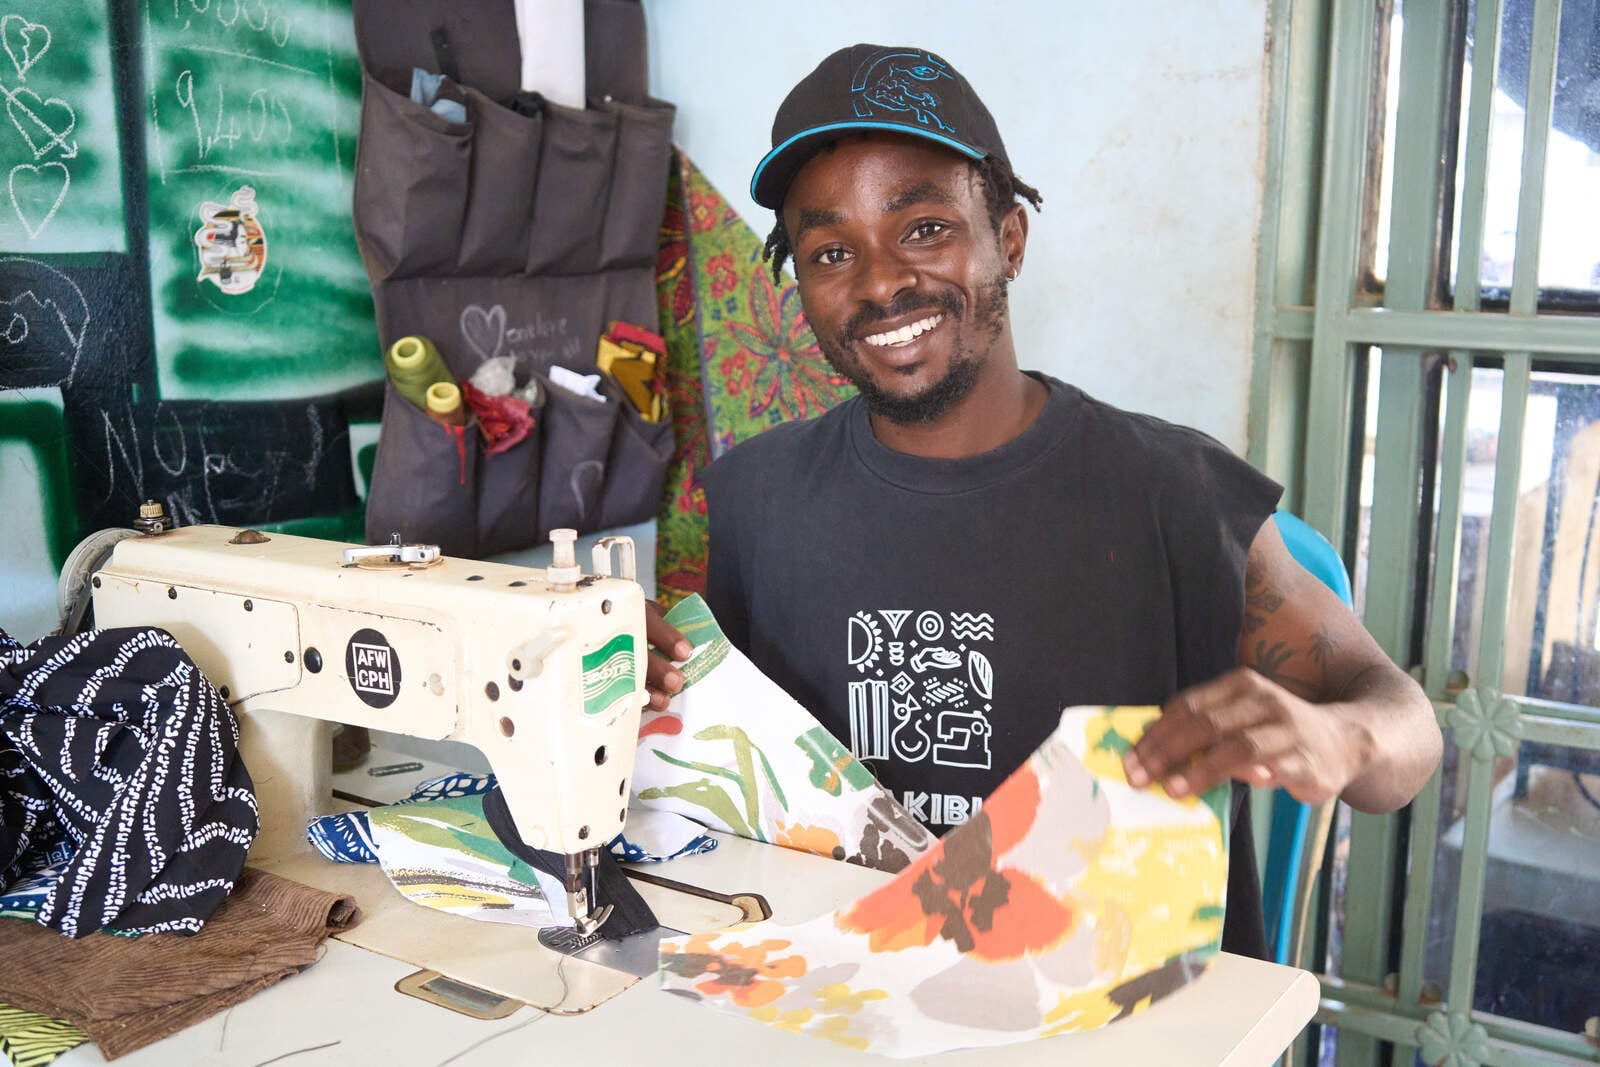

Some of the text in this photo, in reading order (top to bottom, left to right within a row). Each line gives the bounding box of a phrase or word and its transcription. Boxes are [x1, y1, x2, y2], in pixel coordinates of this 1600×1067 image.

[358, 648, 387, 668] AFW
[358, 669, 390, 689] CPH
[884, 788, 983, 826] KIB
